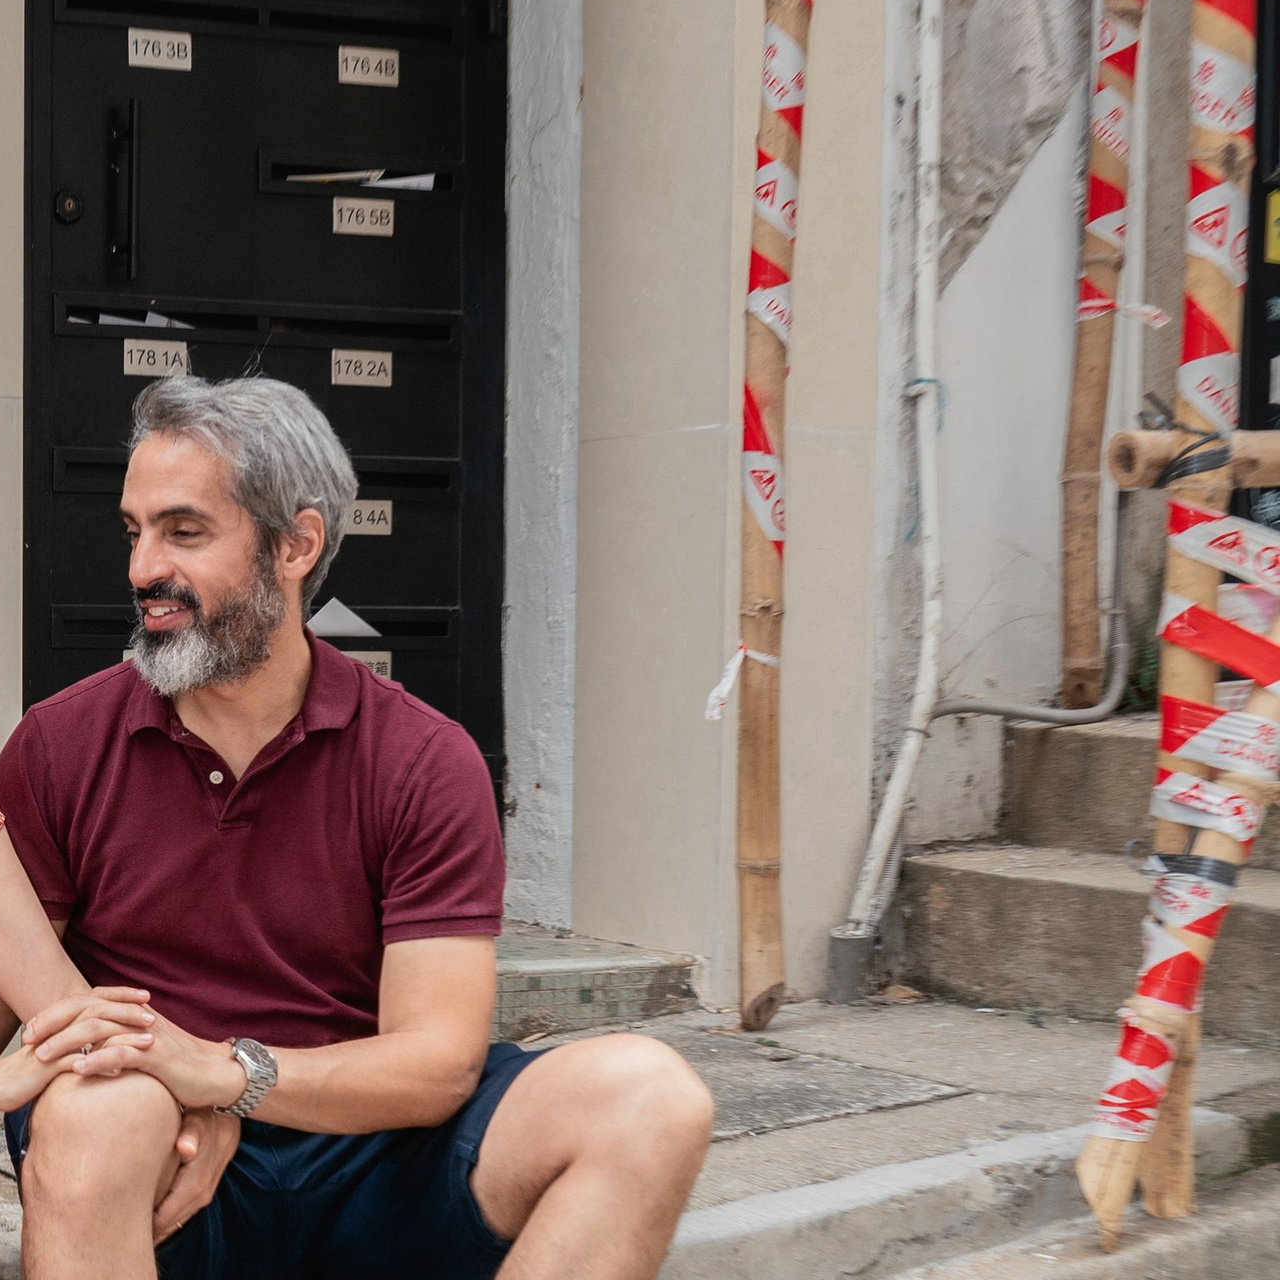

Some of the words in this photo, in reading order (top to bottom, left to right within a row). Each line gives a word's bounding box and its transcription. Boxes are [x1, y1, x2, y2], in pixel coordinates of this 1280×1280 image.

[133, 38, 161, 58] 176
[166, 41, 187, 60] 3B
[342, 56, 370, 75] 176
[337, 206, 365, 226] 176
[369, 208, 390, 227] 5B
[127, 348, 156, 366] 178
[162, 350, 183, 367] 1A
[335, 358, 362, 376] 178
[367, 360, 388, 377] 2A
[366, 509, 388, 526] 4A
